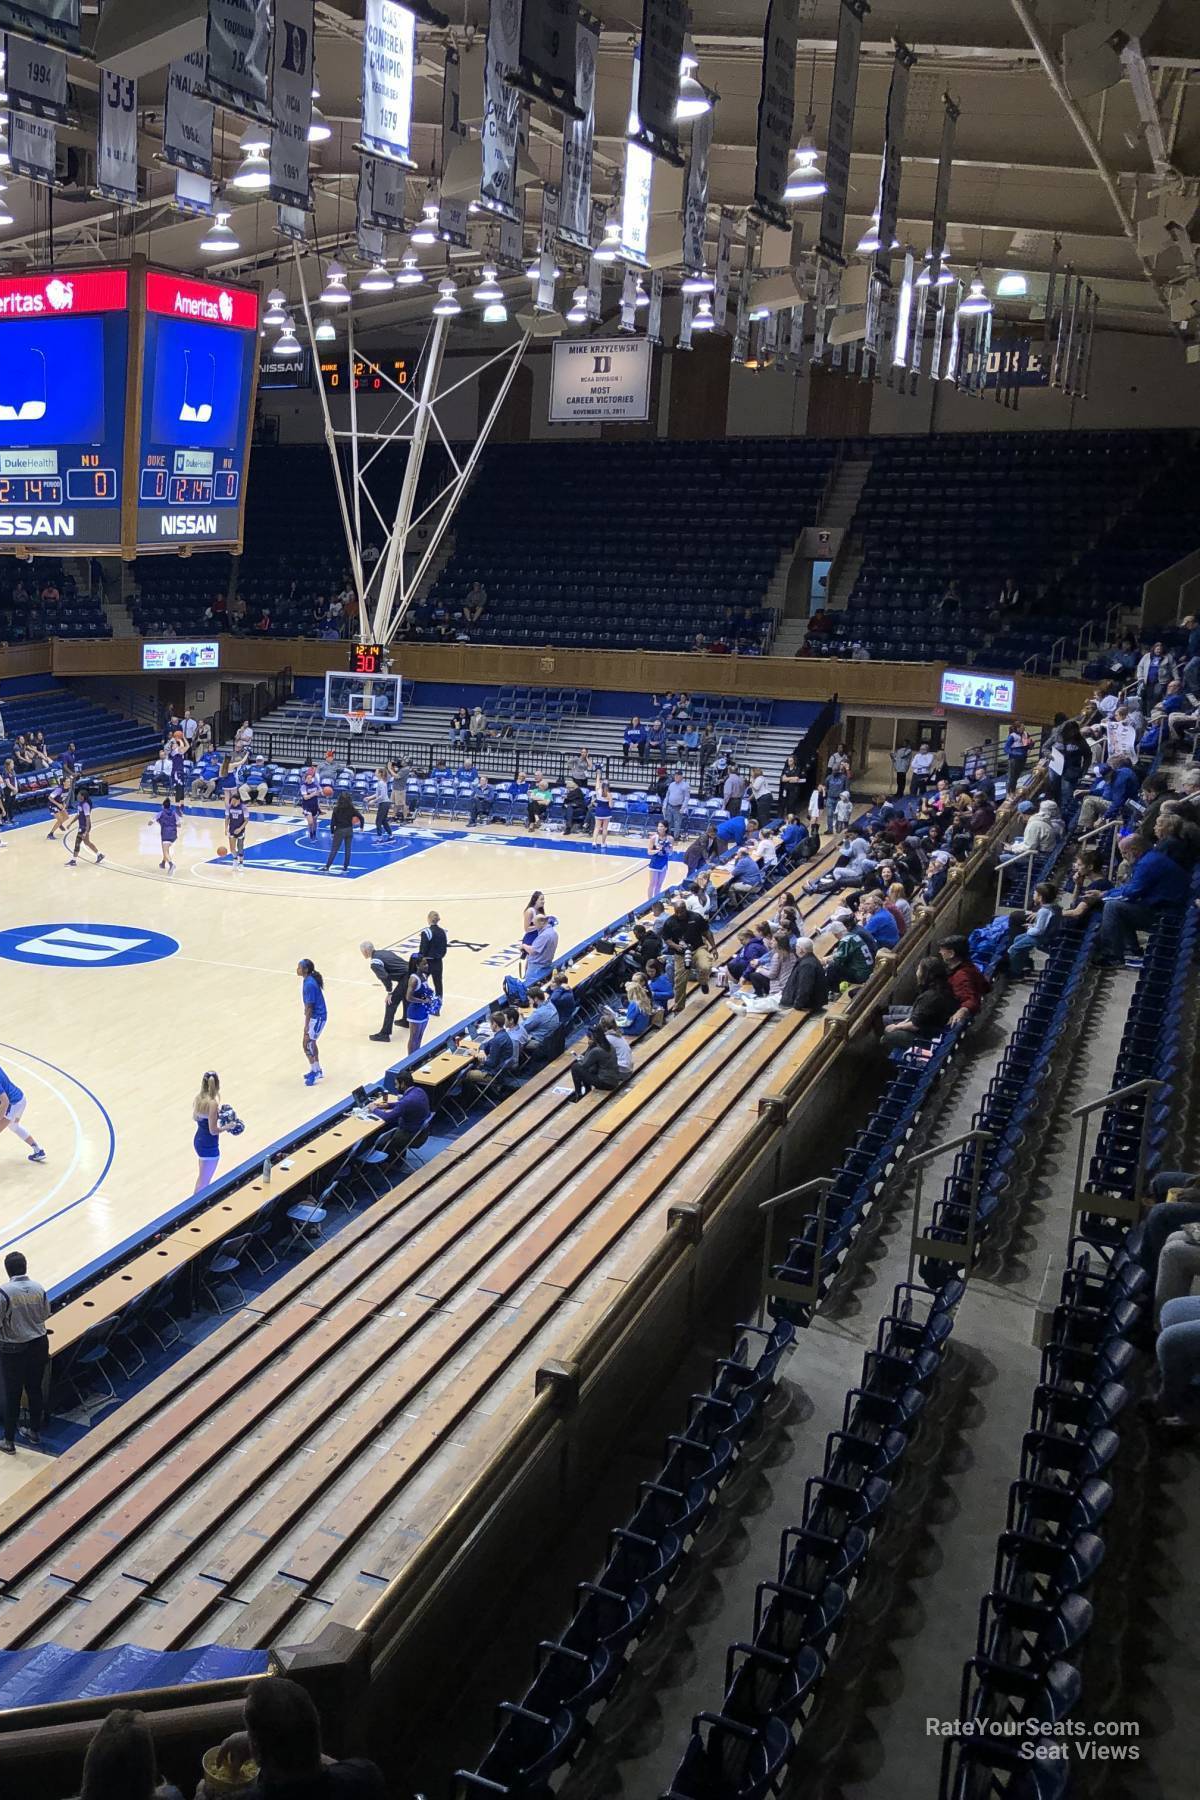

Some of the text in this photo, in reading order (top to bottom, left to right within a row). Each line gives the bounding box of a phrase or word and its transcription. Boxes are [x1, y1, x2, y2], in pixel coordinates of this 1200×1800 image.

[106, 71, 136, 113] 33
[379, 108, 398, 132] 1979
[174, 290, 220, 319] Ameritas
[568, 344, 639, 354] MIKE KRZYZEWSKI
[259, 362, 304, 374] NISSAN
[321, 363, 338, 371] DUKE
[395, 361, 405, 369] NU
[331, 374, 339, 386] 0
[374, 378, 381, 389] 0
[400, 371, 407, 384] 0
[590, 386, 611, 395] MOST
[566, 395, 634, 405] CAREER VICTORIES
[4, 456, 55, 470] DukeHealth
[81, 454, 99, 467] NU
[147, 454, 165, 467] DUKE
[223, 458, 233, 469] NU
[94, 472, 107, 495] 0
[155, 473, 164, 496] 0
[175, 479, 203, 501] 12:14
[226, 474, 234, 497] 0
[51, 486, 57, 499] 1
[161, 515, 217, 535] NISSAN
[355, 645, 379, 655] 12:14
[356, 655, 375, 672] 30
